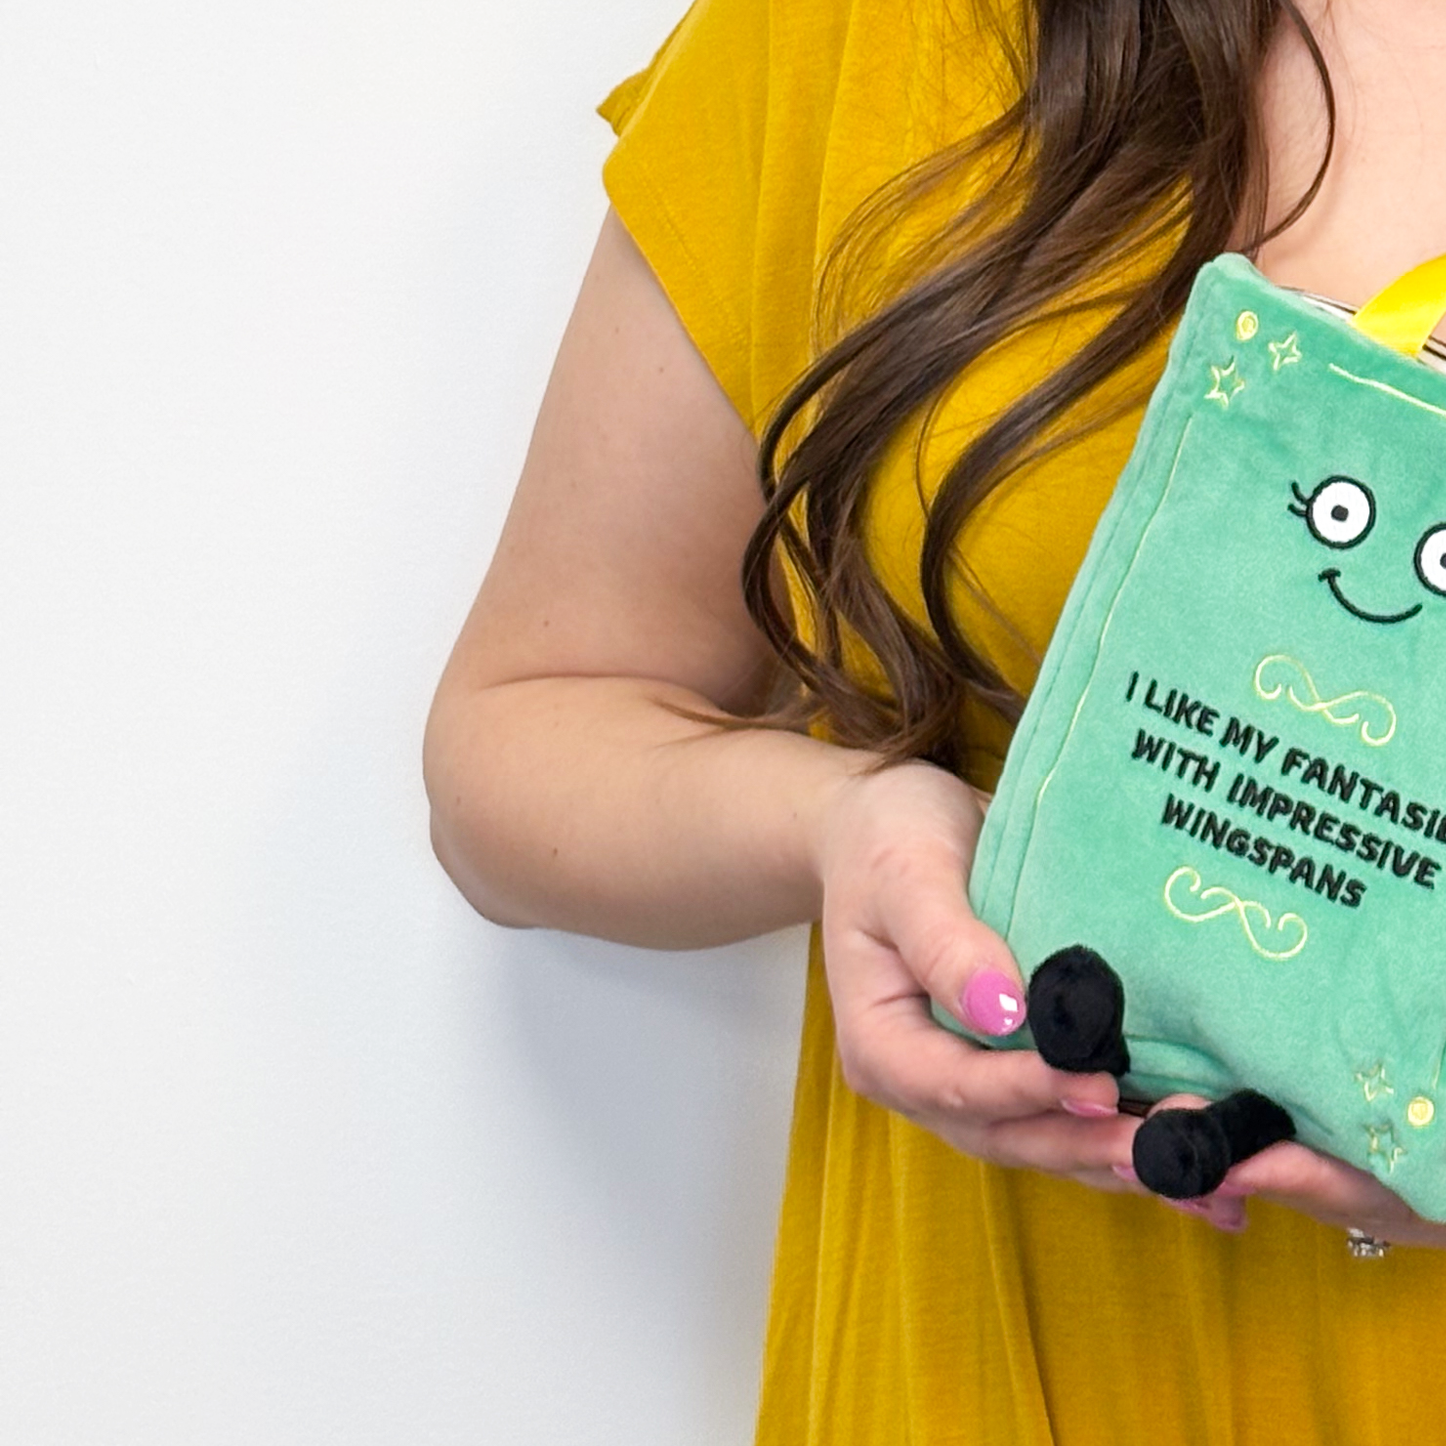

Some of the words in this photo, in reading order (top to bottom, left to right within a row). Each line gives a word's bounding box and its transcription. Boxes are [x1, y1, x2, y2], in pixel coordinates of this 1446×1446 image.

[1126, 670, 1140, 702] I
[1143, 679, 1221, 737] LIKE
[1218, 716, 1280, 765] MY
[1130, 728, 1222, 793] WITH
[1225, 772, 1442, 891] IMPRESSIVE
[1160, 792, 1367, 908] WINGSPANS
